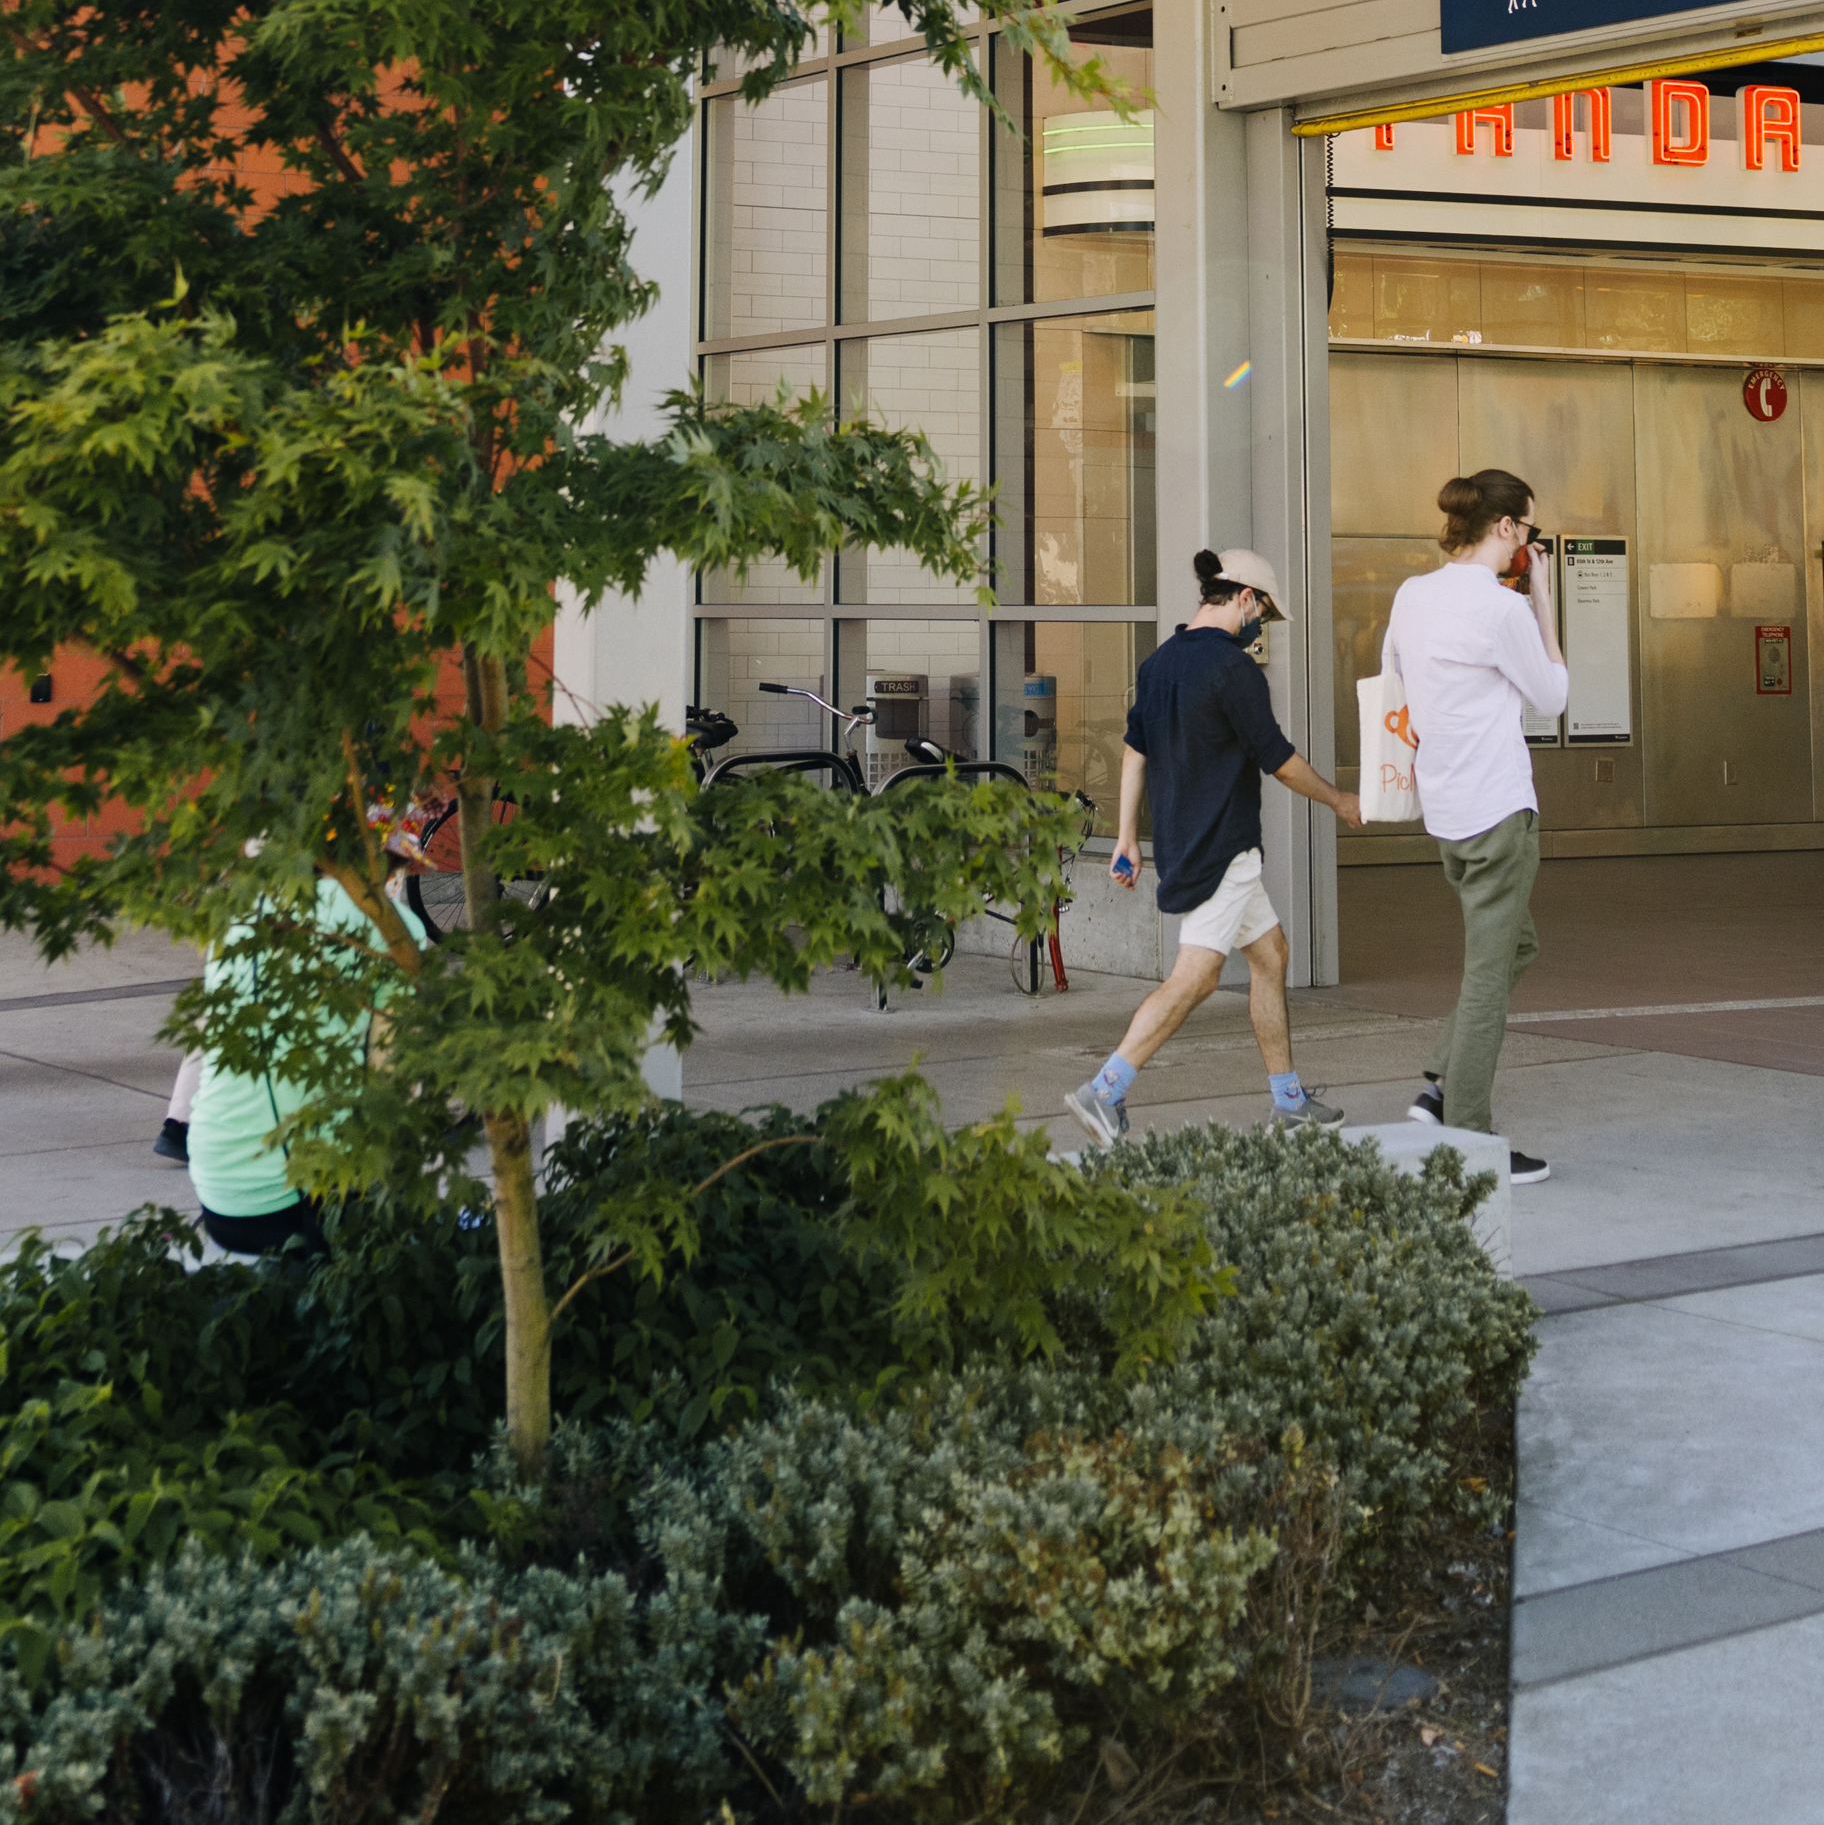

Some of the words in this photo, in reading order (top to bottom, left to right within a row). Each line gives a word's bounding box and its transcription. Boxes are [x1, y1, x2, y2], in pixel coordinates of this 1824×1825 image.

[1748, 370, 1786, 391] EMERGENCY
[1578, 542, 1593, 551] EXIT
[881, 682, 916, 692] TRASH
